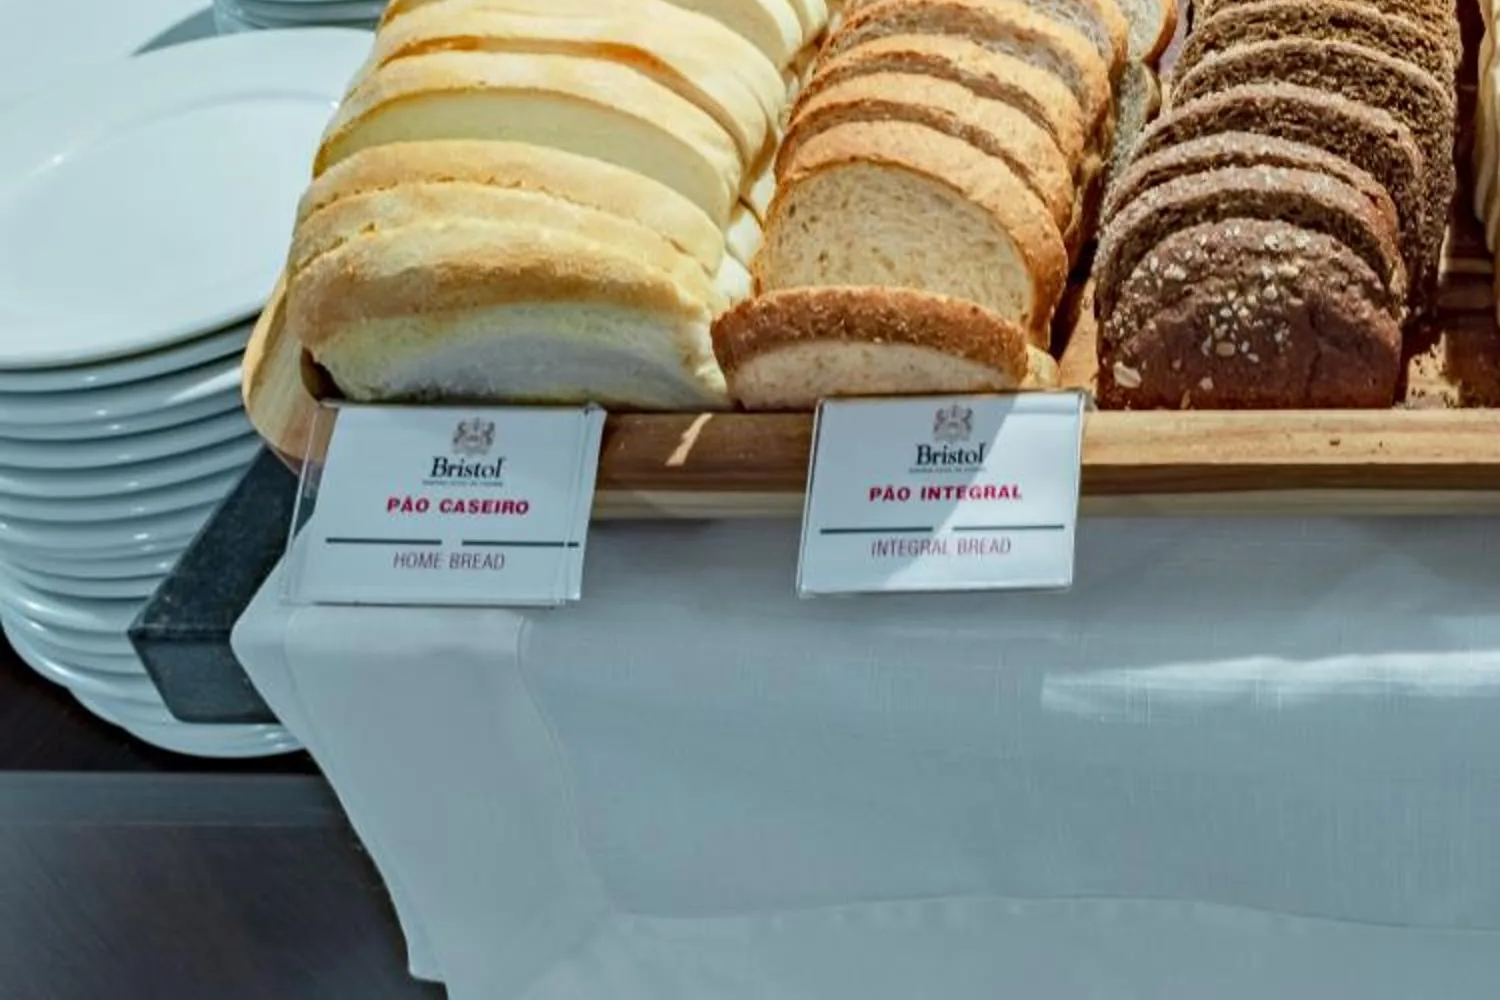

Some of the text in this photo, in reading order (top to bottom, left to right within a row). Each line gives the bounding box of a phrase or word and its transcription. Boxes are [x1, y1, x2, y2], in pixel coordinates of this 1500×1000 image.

[916, 442, 986, 465] Bristol
[431, 455, 506, 478] Bristol
[869, 484, 1022, 502] PÃO INTEGRAL
[387, 496, 529, 515] PÃO CASEIRO
[871, 538, 1011, 557] INTEGRAL BREAD
[393, 552, 505, 570] HOME BREAD
